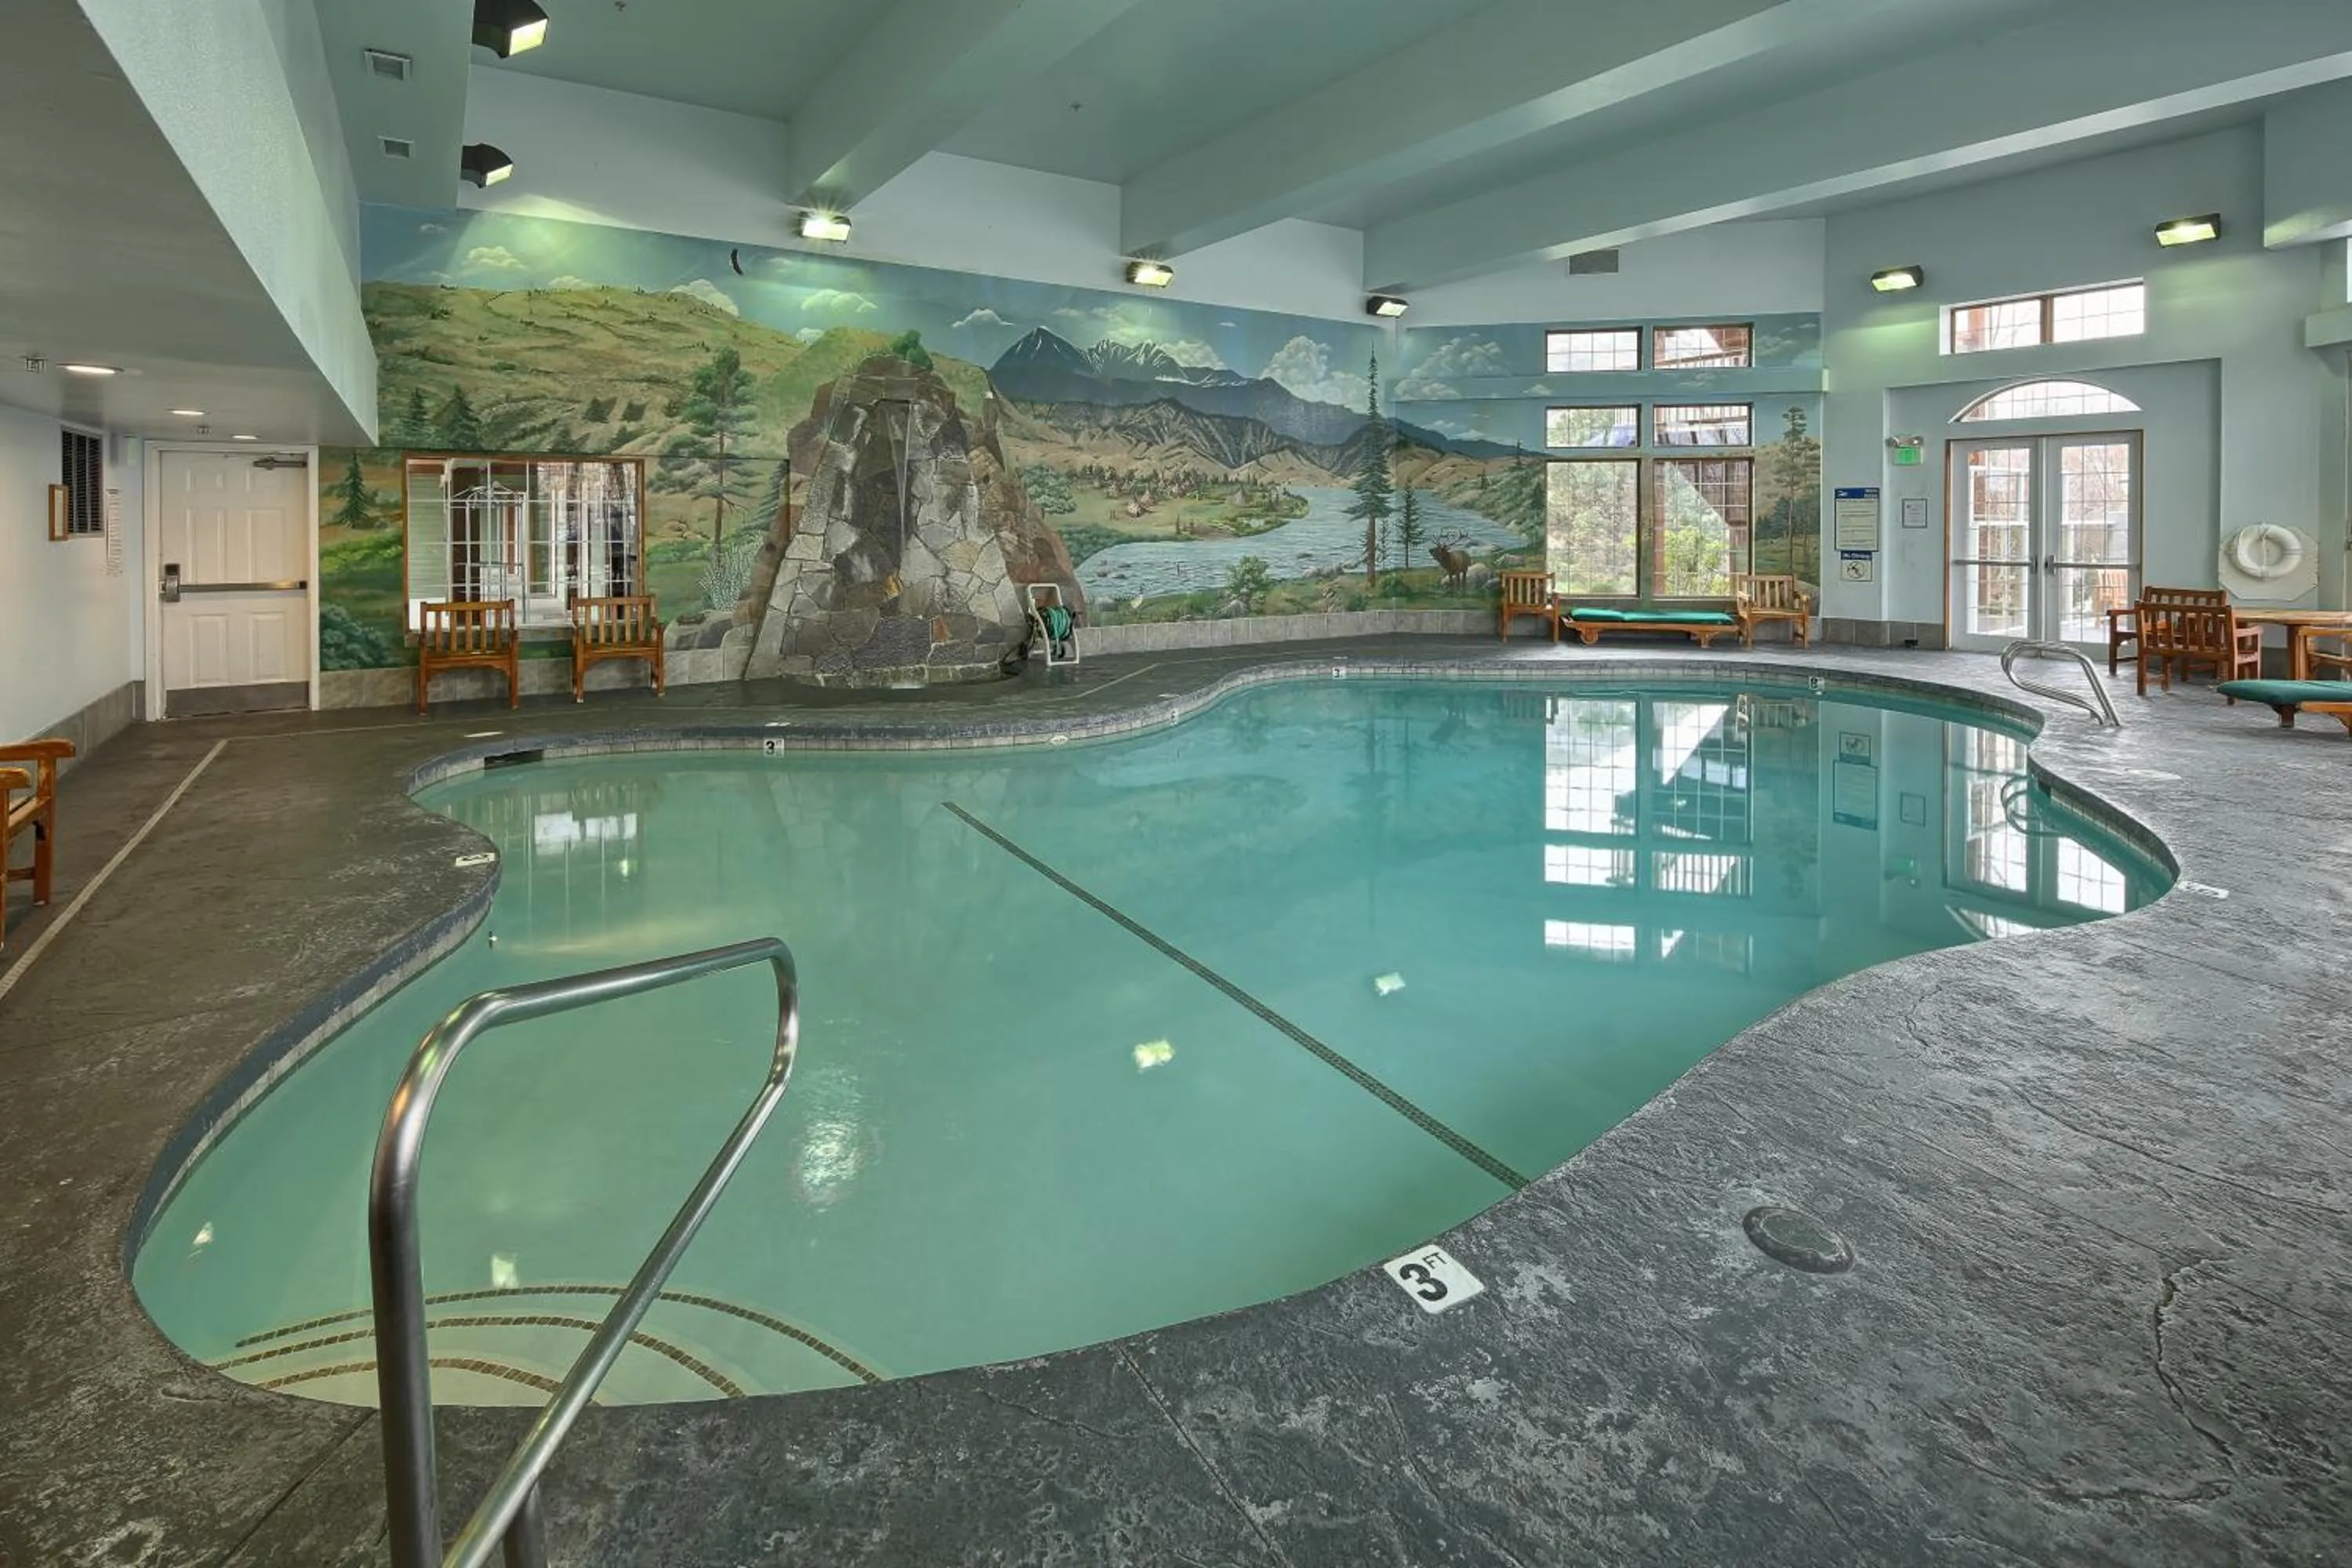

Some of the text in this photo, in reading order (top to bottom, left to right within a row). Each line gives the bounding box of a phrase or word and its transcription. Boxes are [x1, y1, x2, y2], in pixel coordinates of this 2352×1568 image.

[766, 740, 775, 755] 3
[1399, 1252, 1448, 1301] 3 FT
